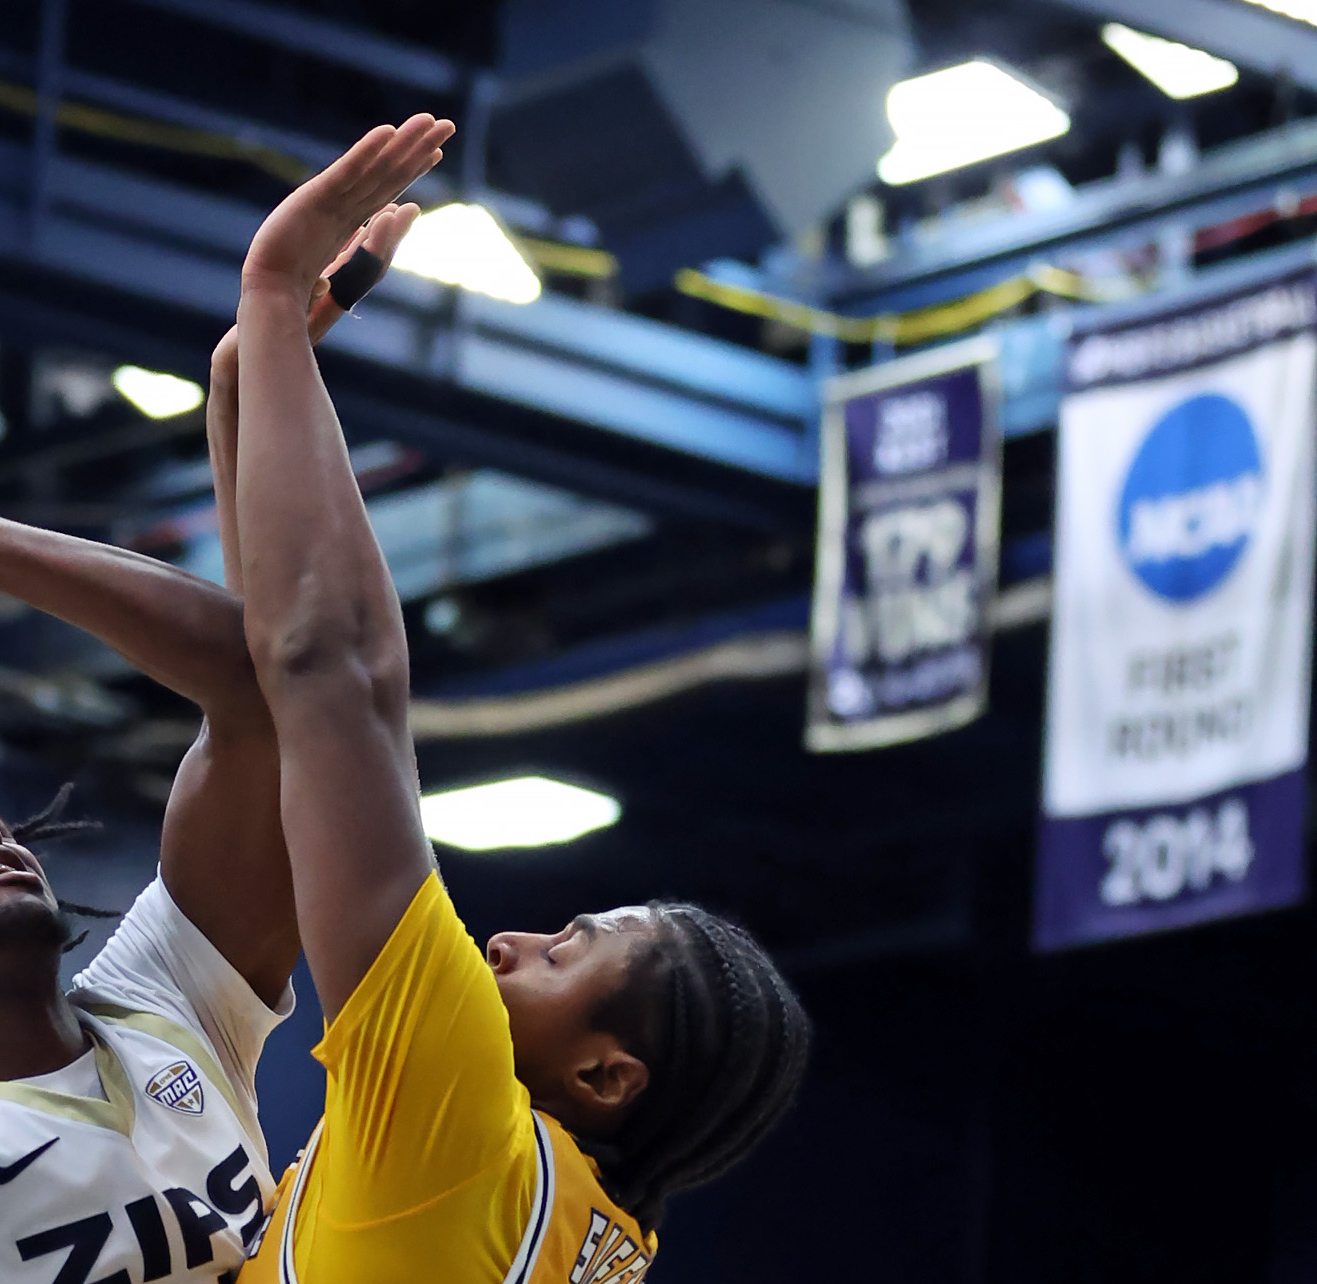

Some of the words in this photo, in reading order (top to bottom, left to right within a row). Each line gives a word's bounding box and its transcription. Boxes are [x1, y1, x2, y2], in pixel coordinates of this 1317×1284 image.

[1128, 472, 1262, 562] NCAA
[1100, 800, 1255, 906] 2014
[156, 1069, 198, 1105] MAC
